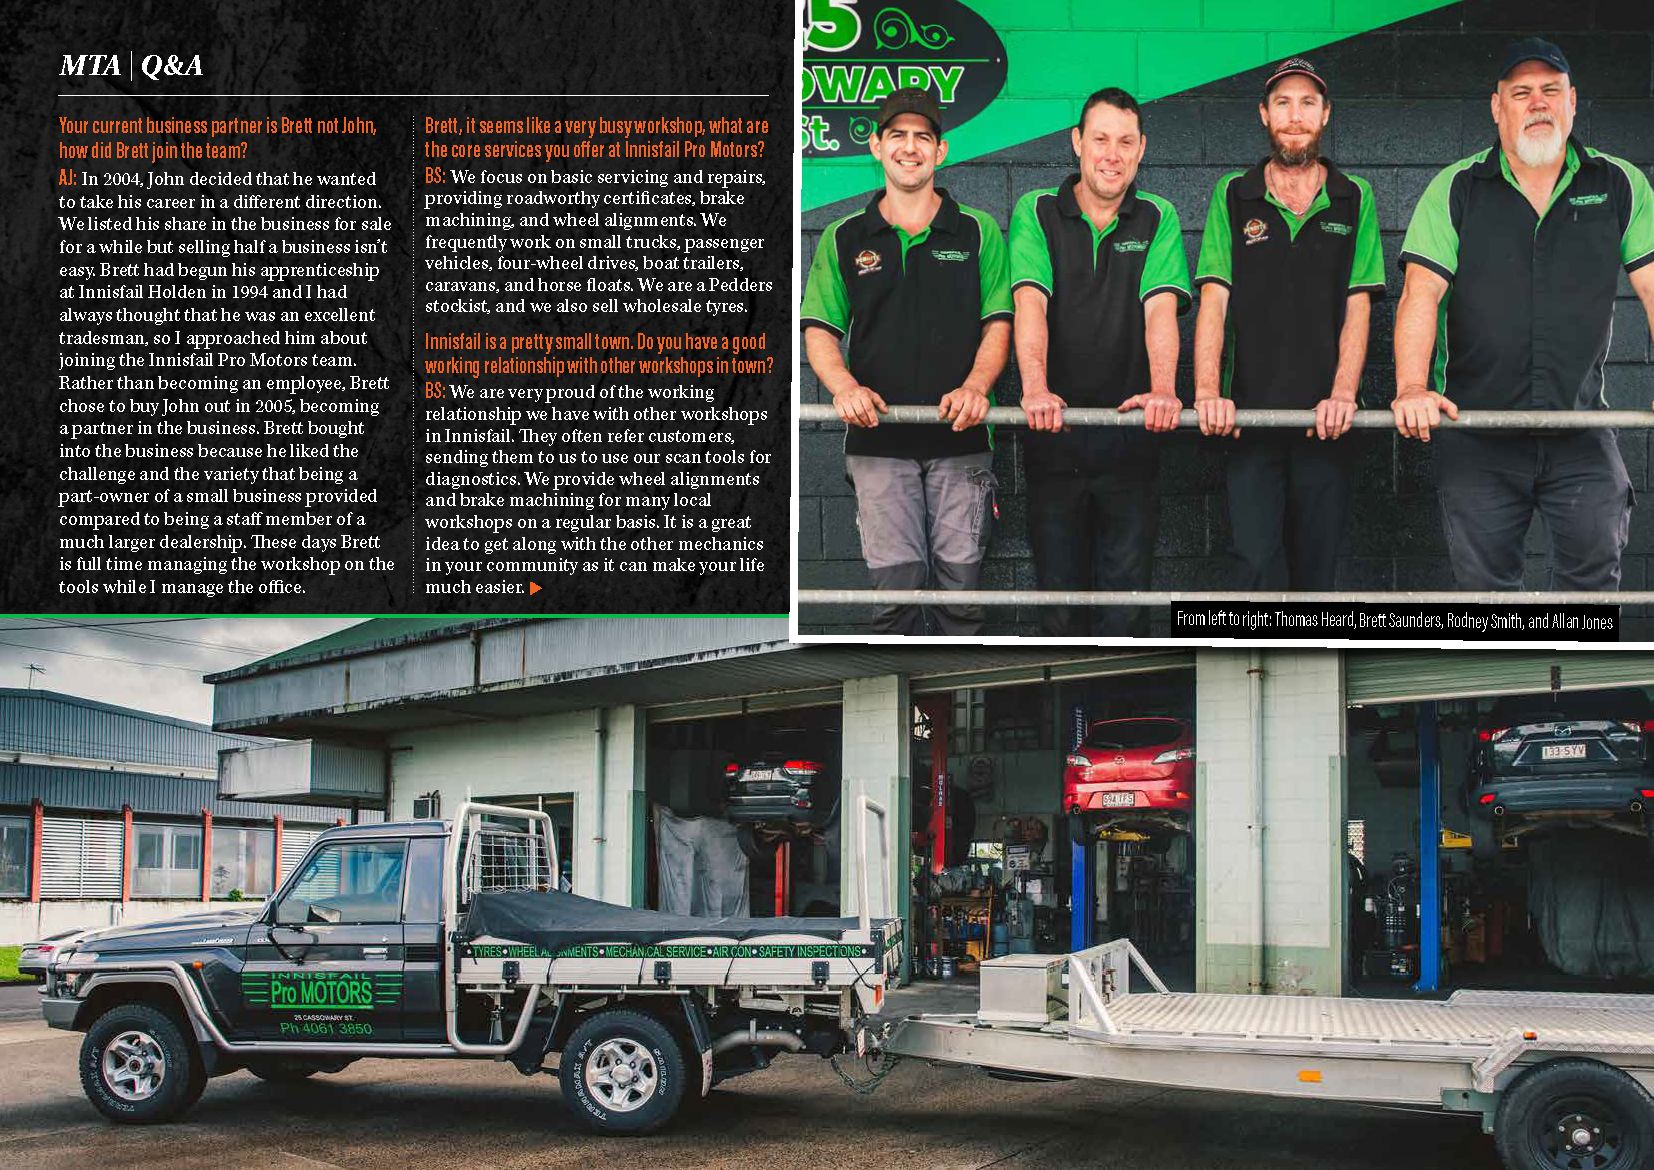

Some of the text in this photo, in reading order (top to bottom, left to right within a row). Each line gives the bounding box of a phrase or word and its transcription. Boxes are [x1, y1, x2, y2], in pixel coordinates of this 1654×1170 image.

[59, 55, 203, 81] MTA Q&A
[59, 117, 376, 137] Your current business partner is Brett not John,
[426, 117, 768, 138] Brett, it seems like a very busy workshop, what are
[60, 142, 247, 163] how did Brett join the team?
[425, 141, 764, 162] the core services you offer at Innisfail Pro Motors?
[59, 169, 376, 189] AJ: In 2004, John decided that he wanted
[426, 167, 765, 188] BS: We focus on basic servicing and repairs,
[60, 263, 379, 281] easy. Brett had begun his apprenticeship
[426, 333, 765, 354] Innisfail is a pretty small town. Do you have a good
[425, 357, 773, 378] working relationship with other workshops in town?
[426, 382, 714, 403] BS: We are very proud of the working
[426, 429, 734, 446] in Innisfail. They often refer customers,
[59, 489, 377, 507] part-owner of a small business provided
[59, 580, 305, 597] tools while I manage the office.
[426, 580, 524, 593] much easier.
[473, 945, 501, 957] TYRES
[508, 945, 538, 957] WHEEL
[666, 945, 706, 957] SERVICE
[712, 945, 729, 957] AIR
[731, 945, 751, 957] CON
[759, 945, 796, 957] SAFETY
[272, 972, 371, 980] INNISFAIL
[271, 981, 373, 1004] Pro MOTORS
[280, 1022, 374, 1035] Ph 4061 3850
